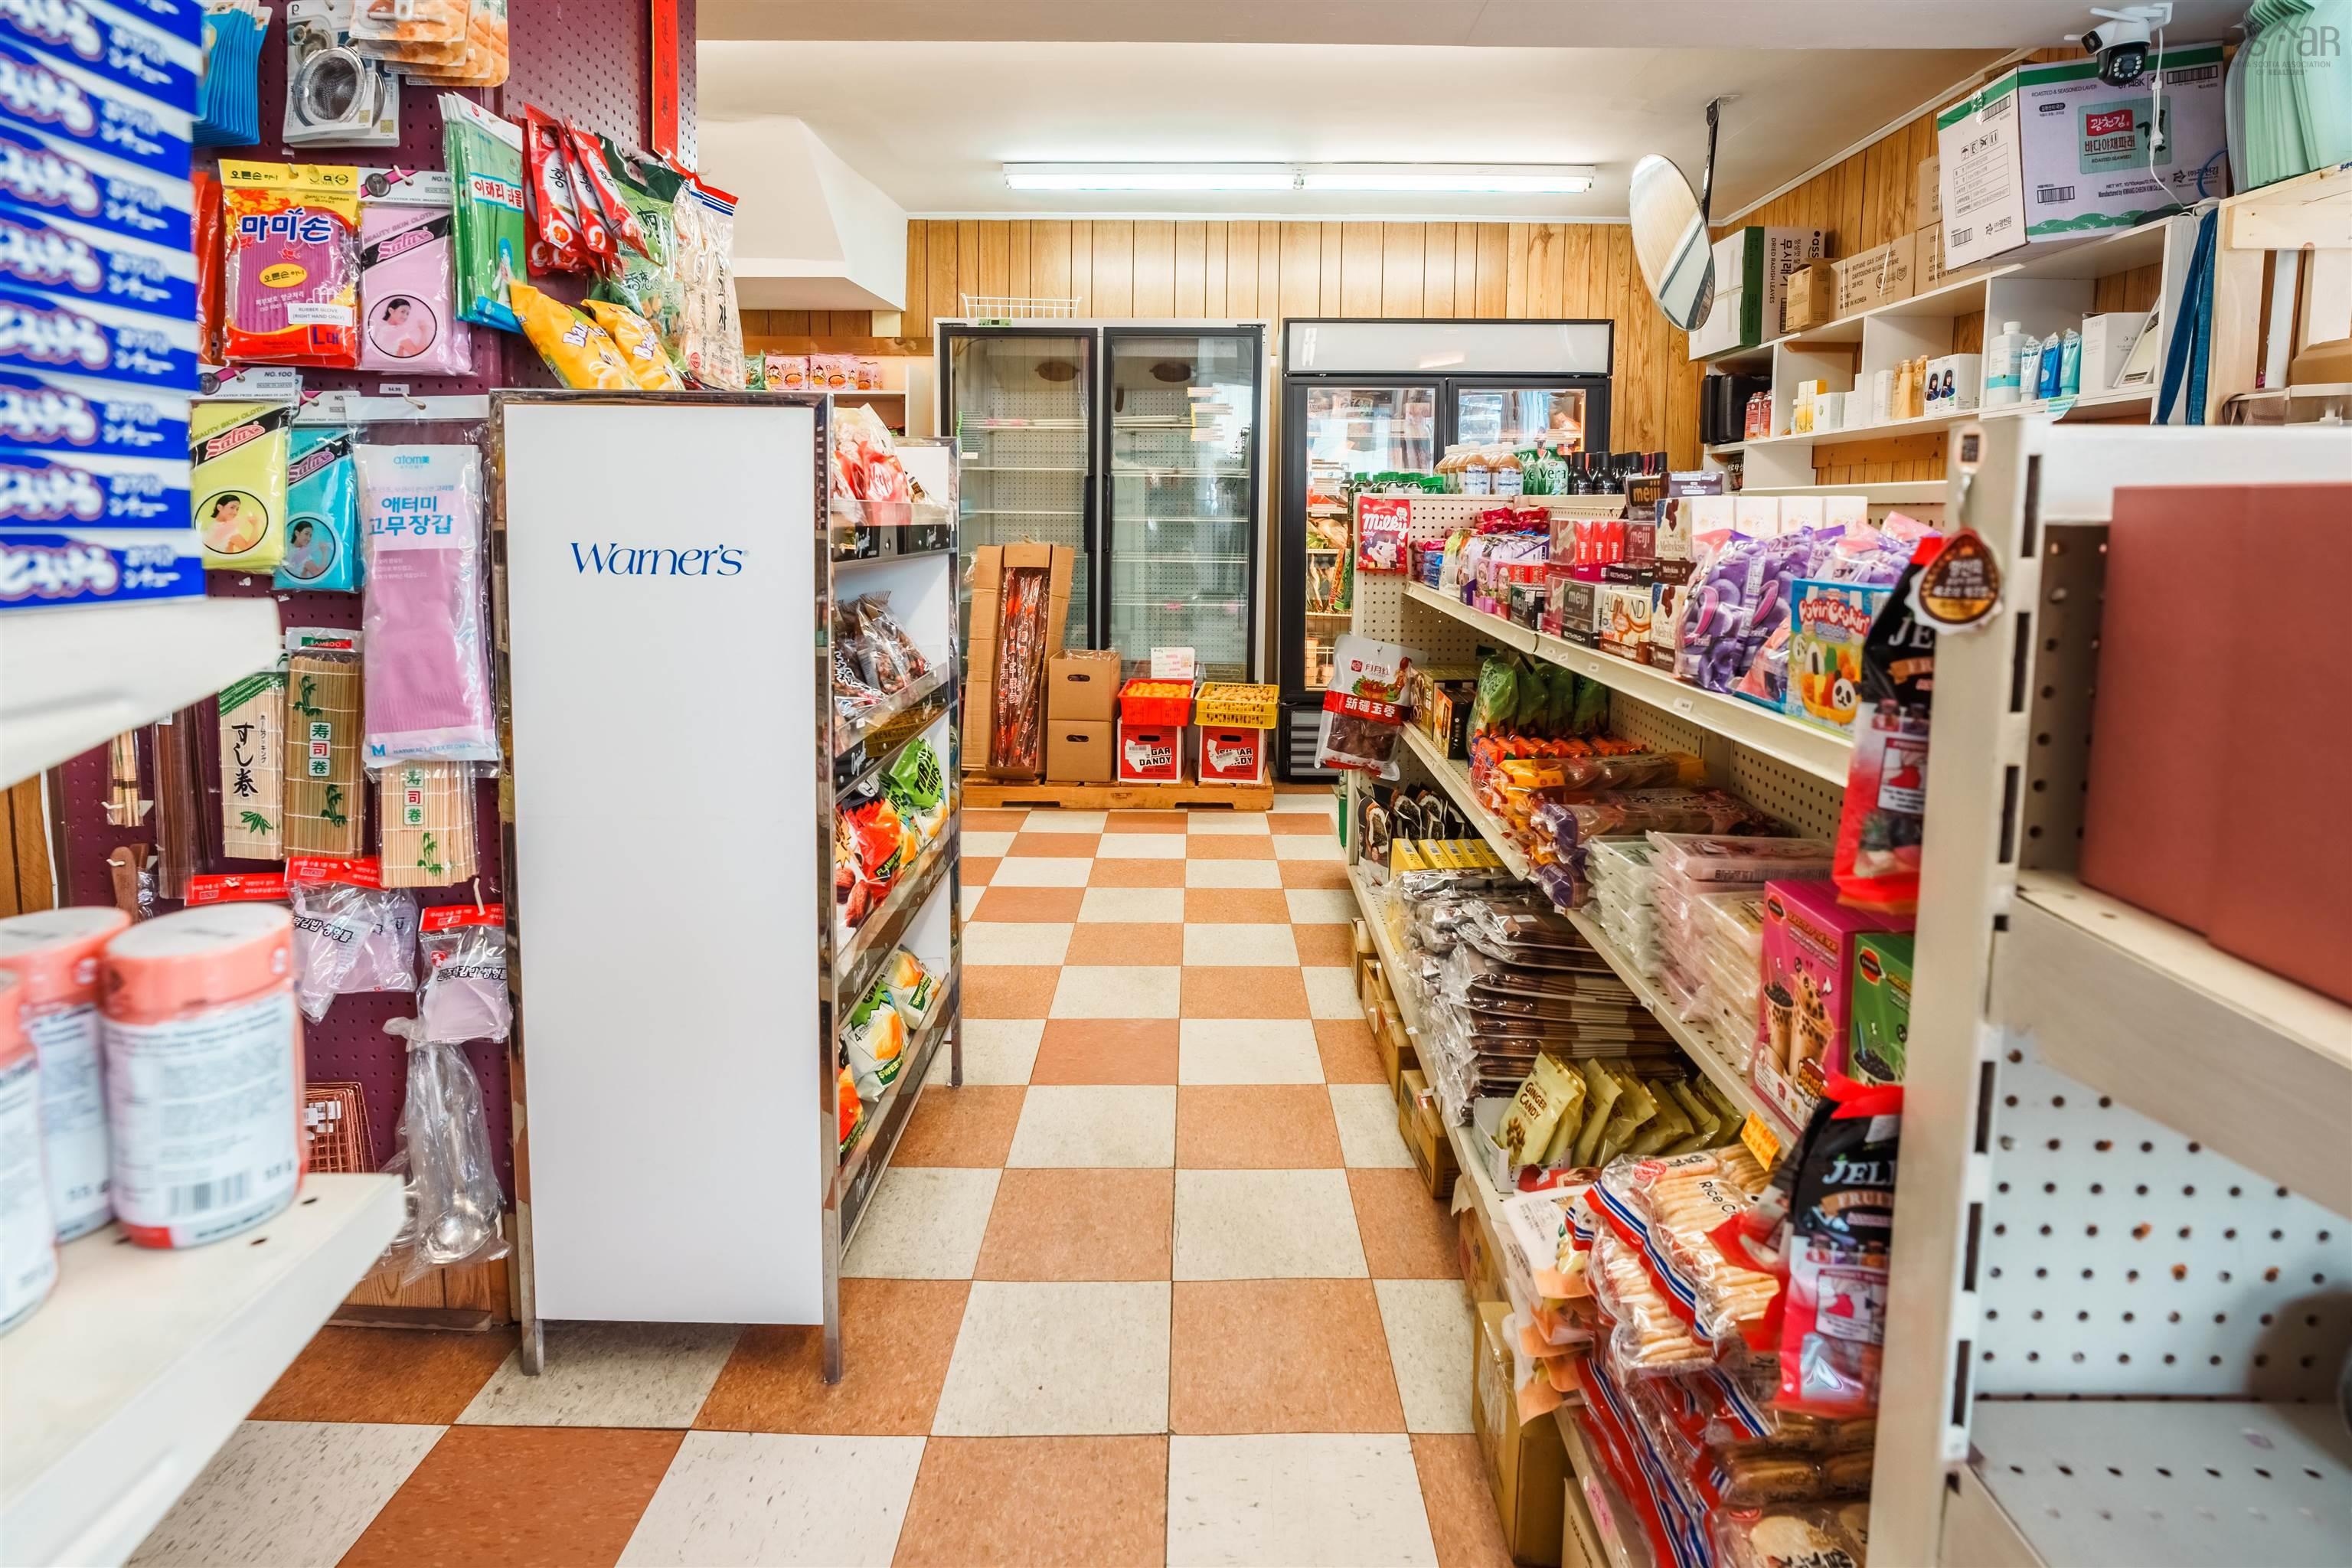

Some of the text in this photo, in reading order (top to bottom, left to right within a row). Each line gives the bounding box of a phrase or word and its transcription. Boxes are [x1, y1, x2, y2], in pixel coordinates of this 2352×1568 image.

[2057, 86, 2081, 95] SEASONED
[2091, 114, 2125, 132] 광천김
[241, 207, 332, 243] 마미손
[364, 210, 436, 243] BEAUTY SKIN CLOTH
[377, 230, 435, 262] Salux
[1852, 261, 1865, 271] BUTANE
[1854, 296, 1867, 305] KOREA
[312, 326, 325, 345] L
[326, 332, 340, 345] 대
[220, 416, 240, 429] SKIN
[240, 405, 266, 420] CLOTH
[204, 423, 266, 460] Salux
[381, 496, 437, 514] 애터미
[369, 514, 453, 536] 고무장갑
[1361, 512, 1410, 540] Milky
[1630, 526, 1651, 549] meiji
[570, 542, 743, 576] Warner's
[1568, 588, 1589, 609] meiji
[1345, 696, 1396, 718] 新疆玉枣
[371, 743, 386, 757] M
[1139, 756, 1172, 766] DANDY
[1151, 746, 1171, 756] GAR
[926, 763, 941, 796] CHIPS
[854, 1031, 863, 1043] 4
[1518, 1093, 1541, 1121] CANDY
[1524, 1081, 1547, 1111] GINGER
[1699, 1180, 1723, 1204] Rice
